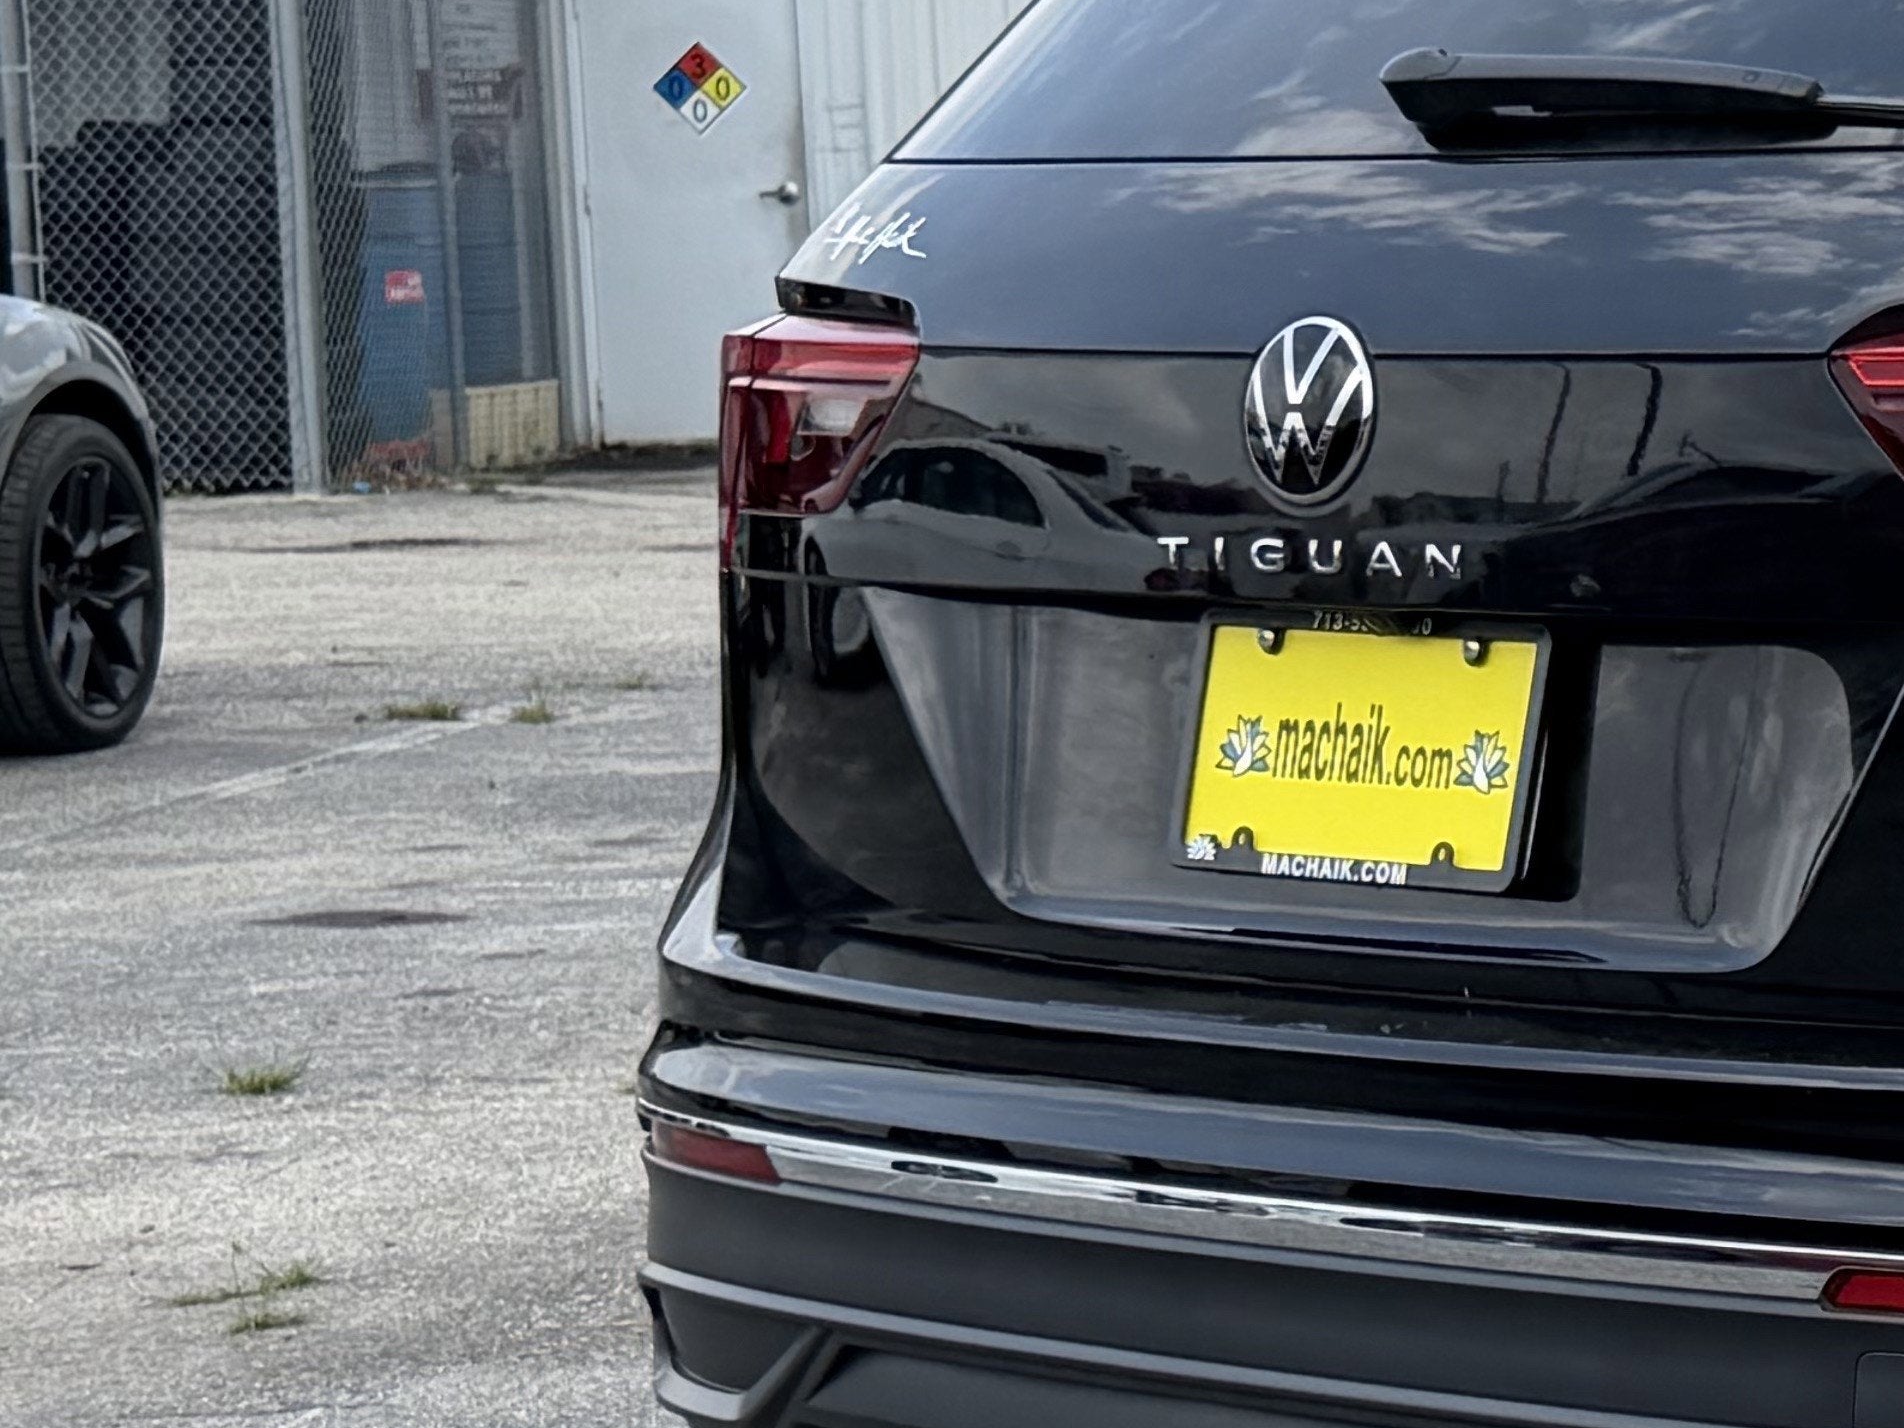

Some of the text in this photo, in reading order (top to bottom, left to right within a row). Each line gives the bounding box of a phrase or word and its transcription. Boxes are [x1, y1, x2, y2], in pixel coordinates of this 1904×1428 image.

[690, 53, 706, 79] 3
[668, 75, 683, 101] 0
[715, 75, 730, 101] 0
[692, 98, 708, 123] 0
[1157, 536, 1464, 580] TIGUAN
[1271, 701, 1454, 790] machaik.com
[1261, 852, 1408, 885] MACHAIK.COM
